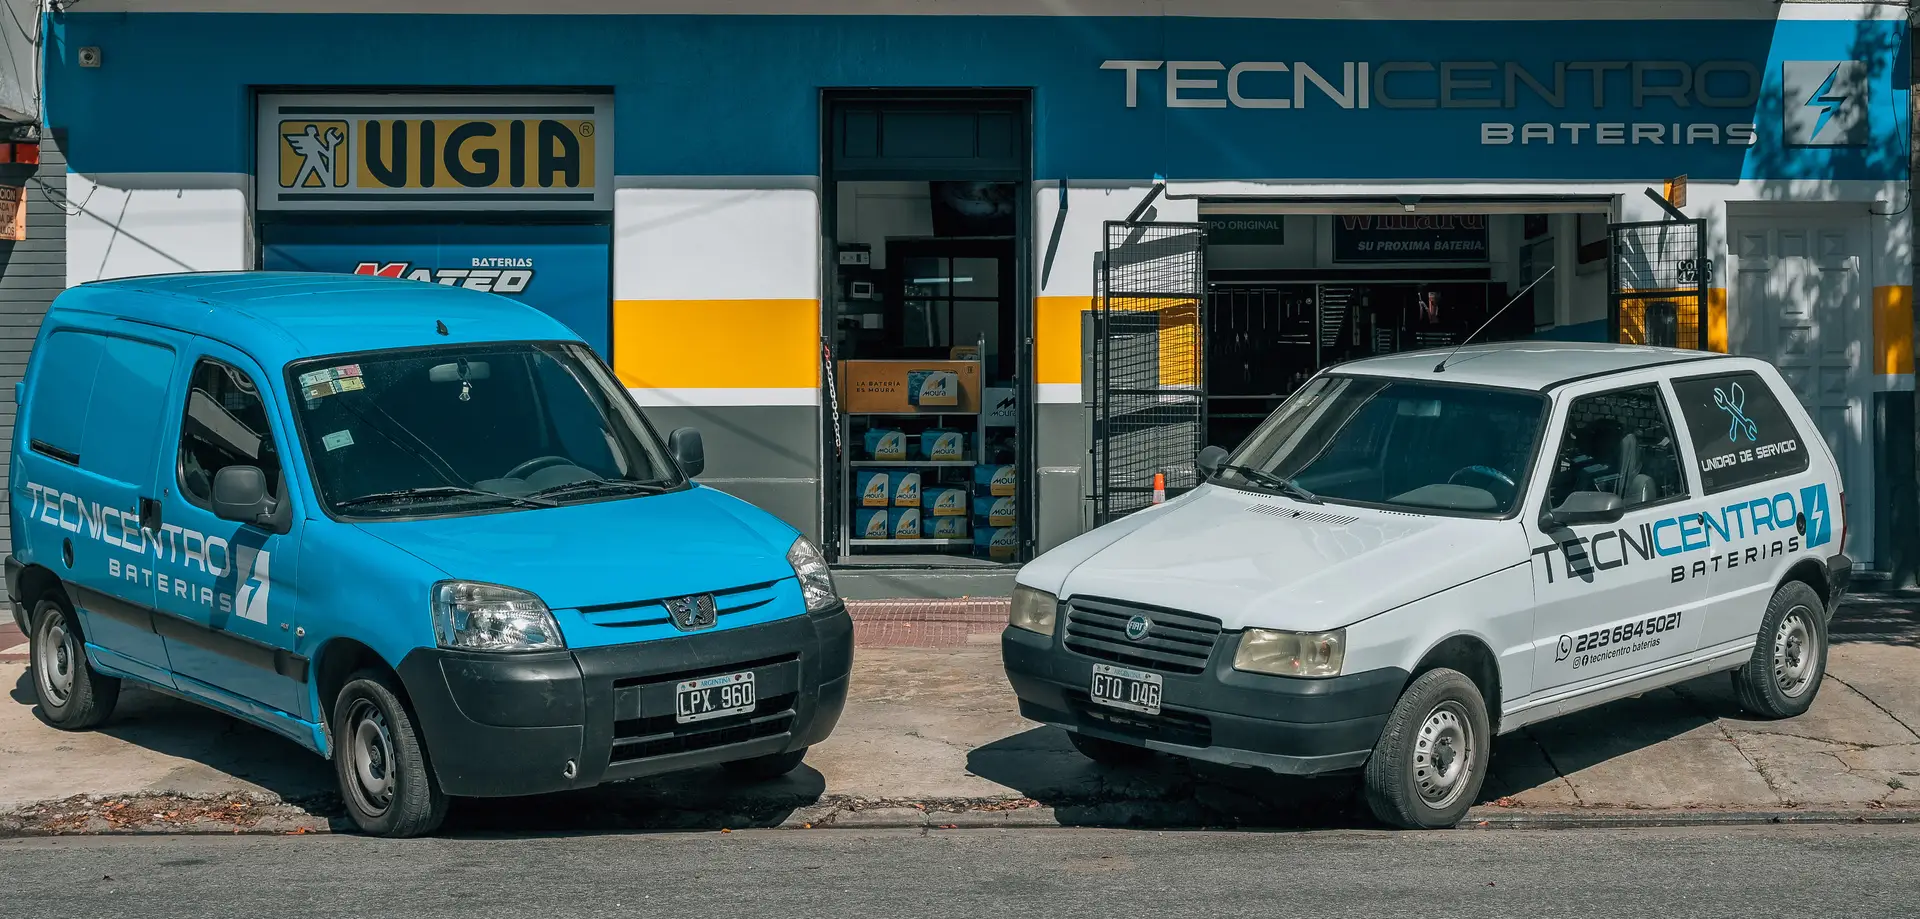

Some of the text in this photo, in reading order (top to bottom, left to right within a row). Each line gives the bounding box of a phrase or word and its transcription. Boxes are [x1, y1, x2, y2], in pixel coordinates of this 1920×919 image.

[1100, 60, 1761, 109] TECNICENTRO
[1481, 122, 1758, 145] BATERIAS
[365, 119, 580, 188] VIGIA
[1228, 220, 1280, 231] ORIGINAL
[472, 257, 533, 267] BATERIAS
[1357, 241, 1374, 251] SU
[1376, 241, 1431, 251] PROXIMA
[1701, 439, 1797, 472] UNIDAD DE SERVICIO
[26, 481, 231, 579] TECNICENTRO
[1532, 491, 1798, 584] TECNICENTRO
[1671, 536, 1799, 584] BATERIAS
[108, 557, 232, 613] BATERIAS
[1129, 621, 1144, 631] FIAT
[1589, 637, 1661, 664] tecnicentro baterias
[680, 682, 752, 717] LPX 960
[1130, 682, 1159, 707] 046
